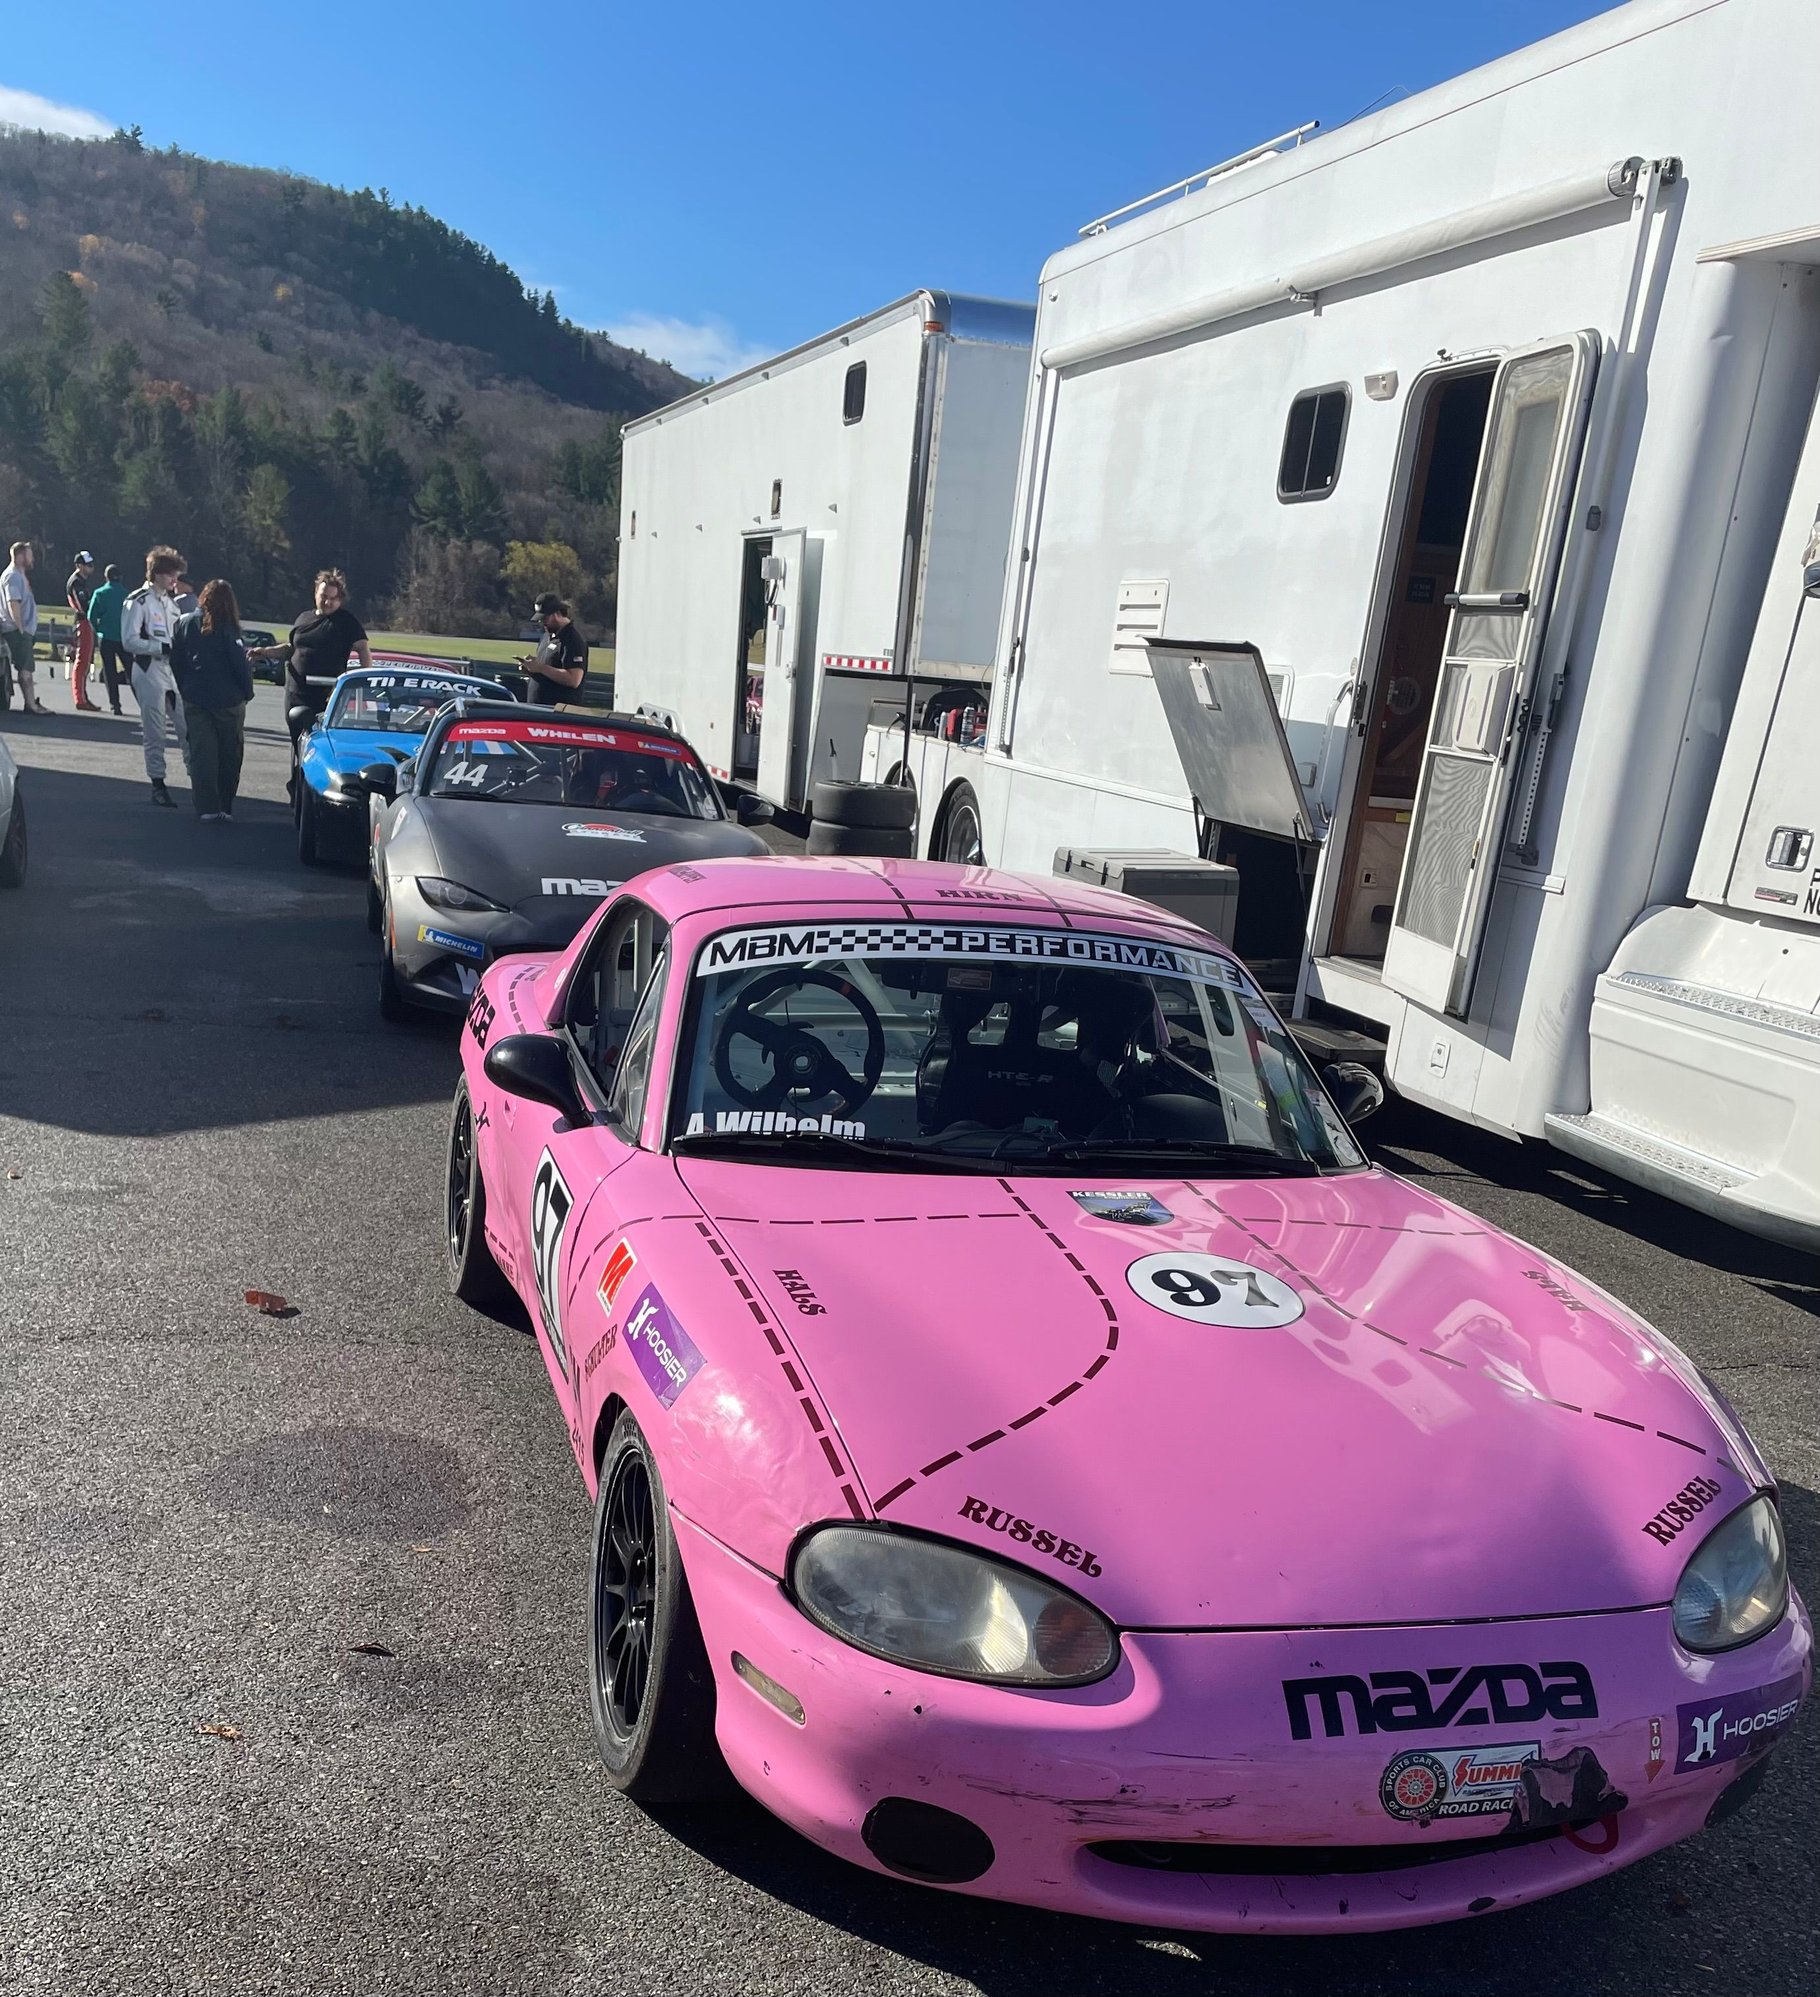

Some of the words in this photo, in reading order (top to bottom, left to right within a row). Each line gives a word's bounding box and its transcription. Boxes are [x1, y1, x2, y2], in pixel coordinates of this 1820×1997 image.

[421, 679, 482, 696] RACK
[527, 727, 616, 745] WHELEN
[443, 761, 489, 787] 44
[935, 889, 1025, 902] HIRN
[435, 934, 479, 953] MICHELIN
[709, 931, 815, 967] MBM
[961, 932, 1241, 987] PERFORMANCE
[716, 1111, 866, 1140] Wilhelm
[532, 1160, 571, 1320] 97
[771, 1269, 828, 1316] HALS
[1151, 1268, 1280, 1309] 97
[642, 1320, 687, 1388] HOOSIER
[1641, 1475, 1722, 1547] RUSSEL
[957, 1495, 1103, 1578] RUSSEL
[1281, 1661, 1600, 1741] mazda
[1723, 1700, 1799, 1741] HOOSIER
[1650, 1722, 1661, 1762] TOW
[1385, 1758, 1410, 1791] SPORTS
[1412, 1755, 1433, 1766] CAR
[1432, 1763, 1446, 1788] CLUB
[1453, 1757, 1522, 1790] SUMMI
[1388, 1800, 1400, 1811] OF
[1438, 1802, 1480, 1816] ROAD
